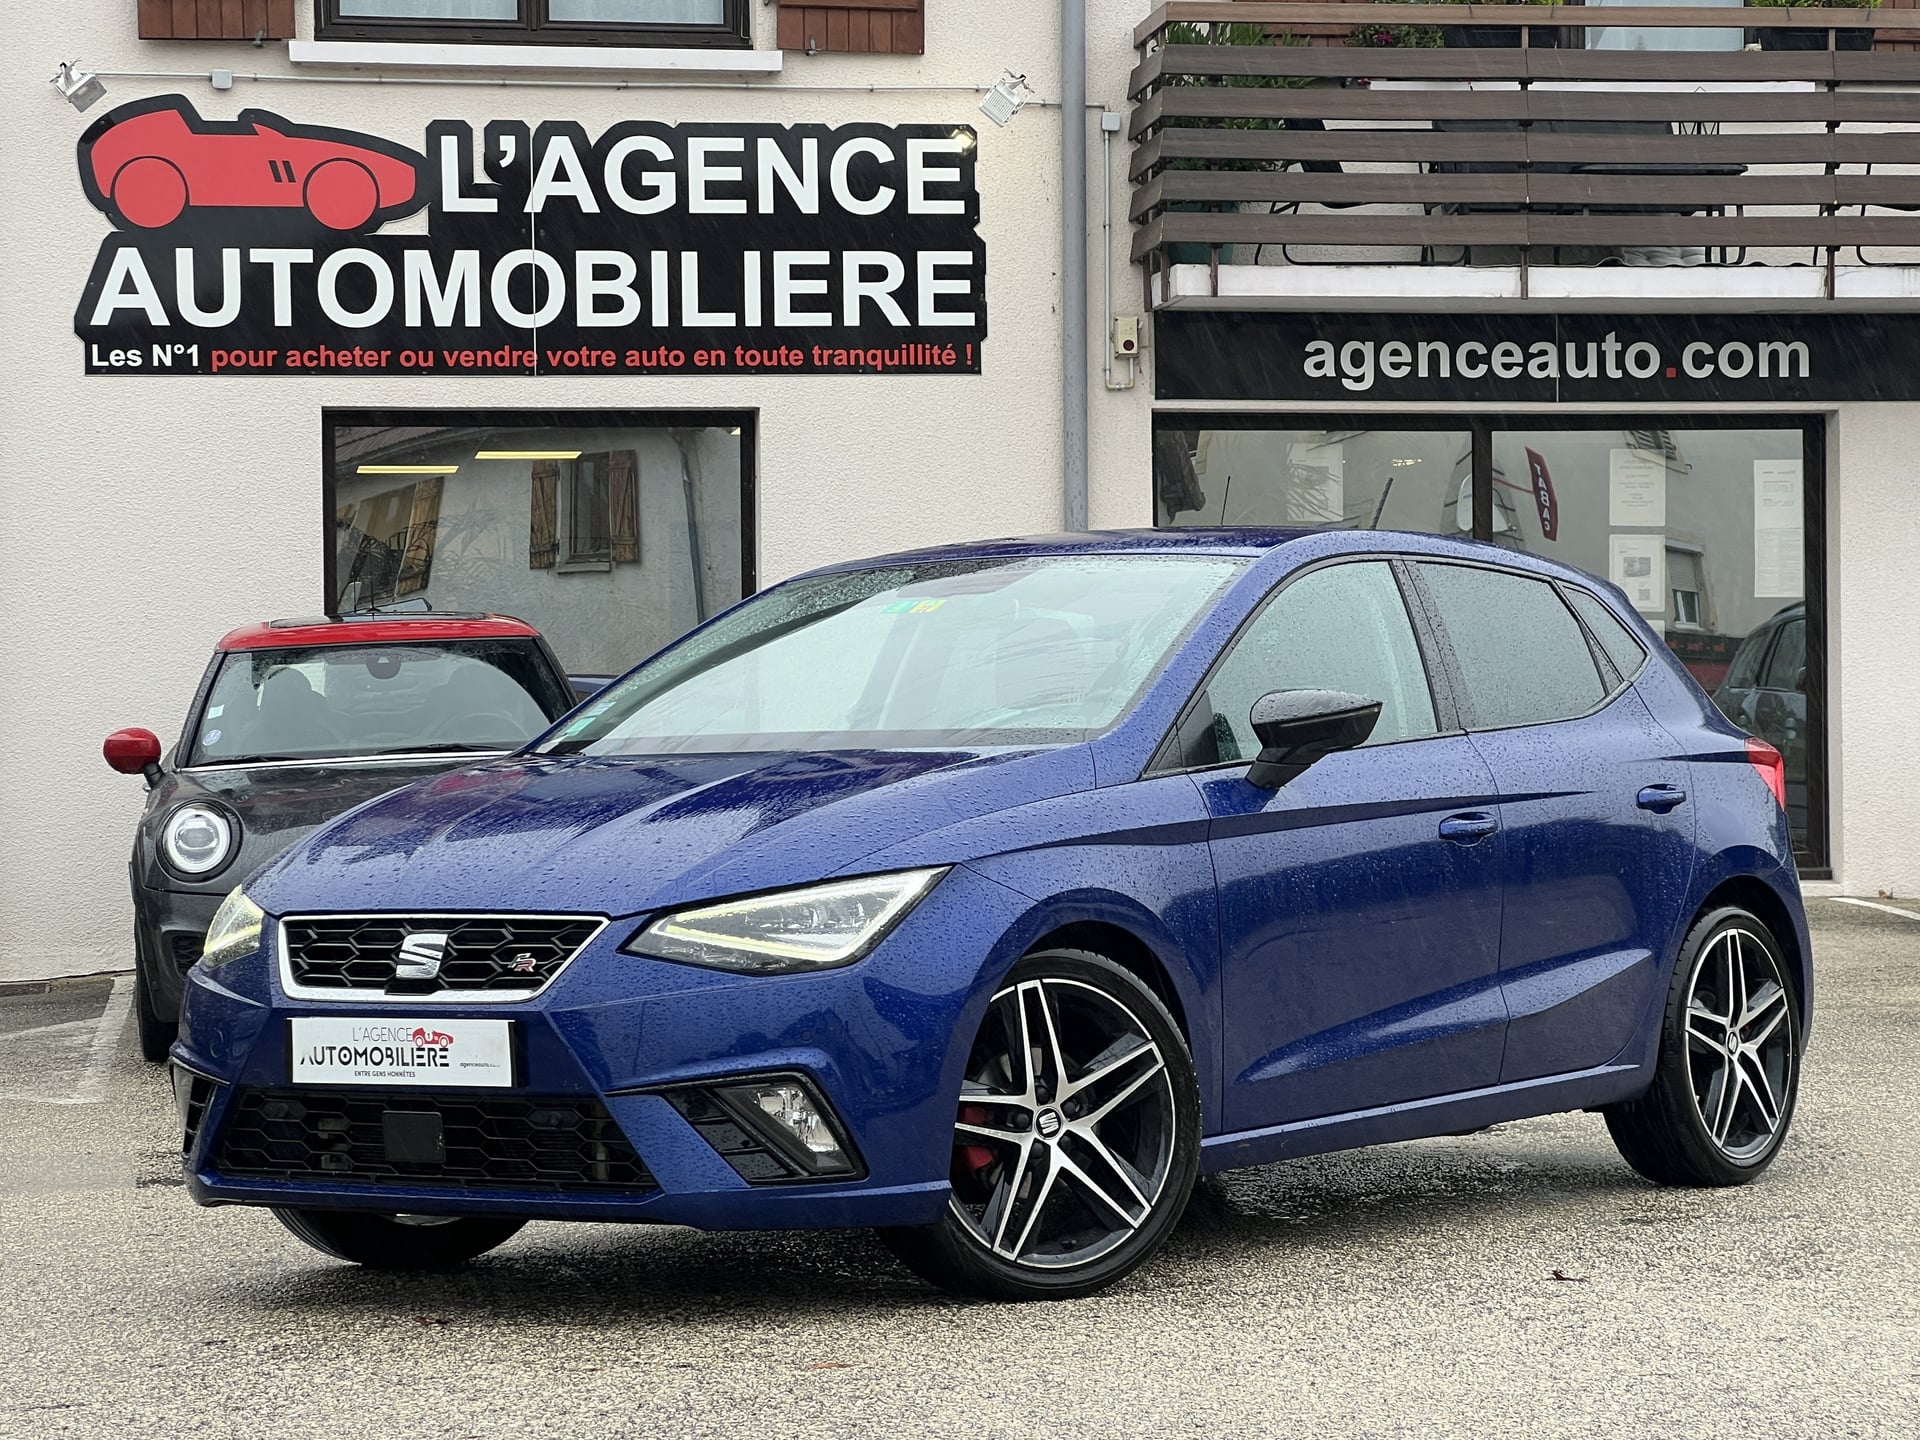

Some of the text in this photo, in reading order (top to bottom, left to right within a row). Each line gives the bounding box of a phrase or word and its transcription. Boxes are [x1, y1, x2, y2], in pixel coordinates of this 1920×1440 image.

[440, 134, 966, 216] L'AGENCE
[89, 246, 976, 328] AUTOMOBILIERE
[91, 343, 143, 367] Les
[152, 343, 200, 367] N°1
[211, 349, 278, 372] pour
[285, 344, 392, 368] acheter
[399, 350, 434, 368] ou
[442, 344, 538, 368] vendre
[546, 345, 617, 367] votre
[625, 345, 686, 367] auto
[693, 349, 726, 367] en
[734, 345, 804, 367] toute
[811, 343, 957, 371] tranquillité
[1303, 331, 1810, 391] agenceauto.com
[300, 1046, 450, 1067] AUTOMOBILIERE
[352, 1027, 412, 1042] L'AGENCE
